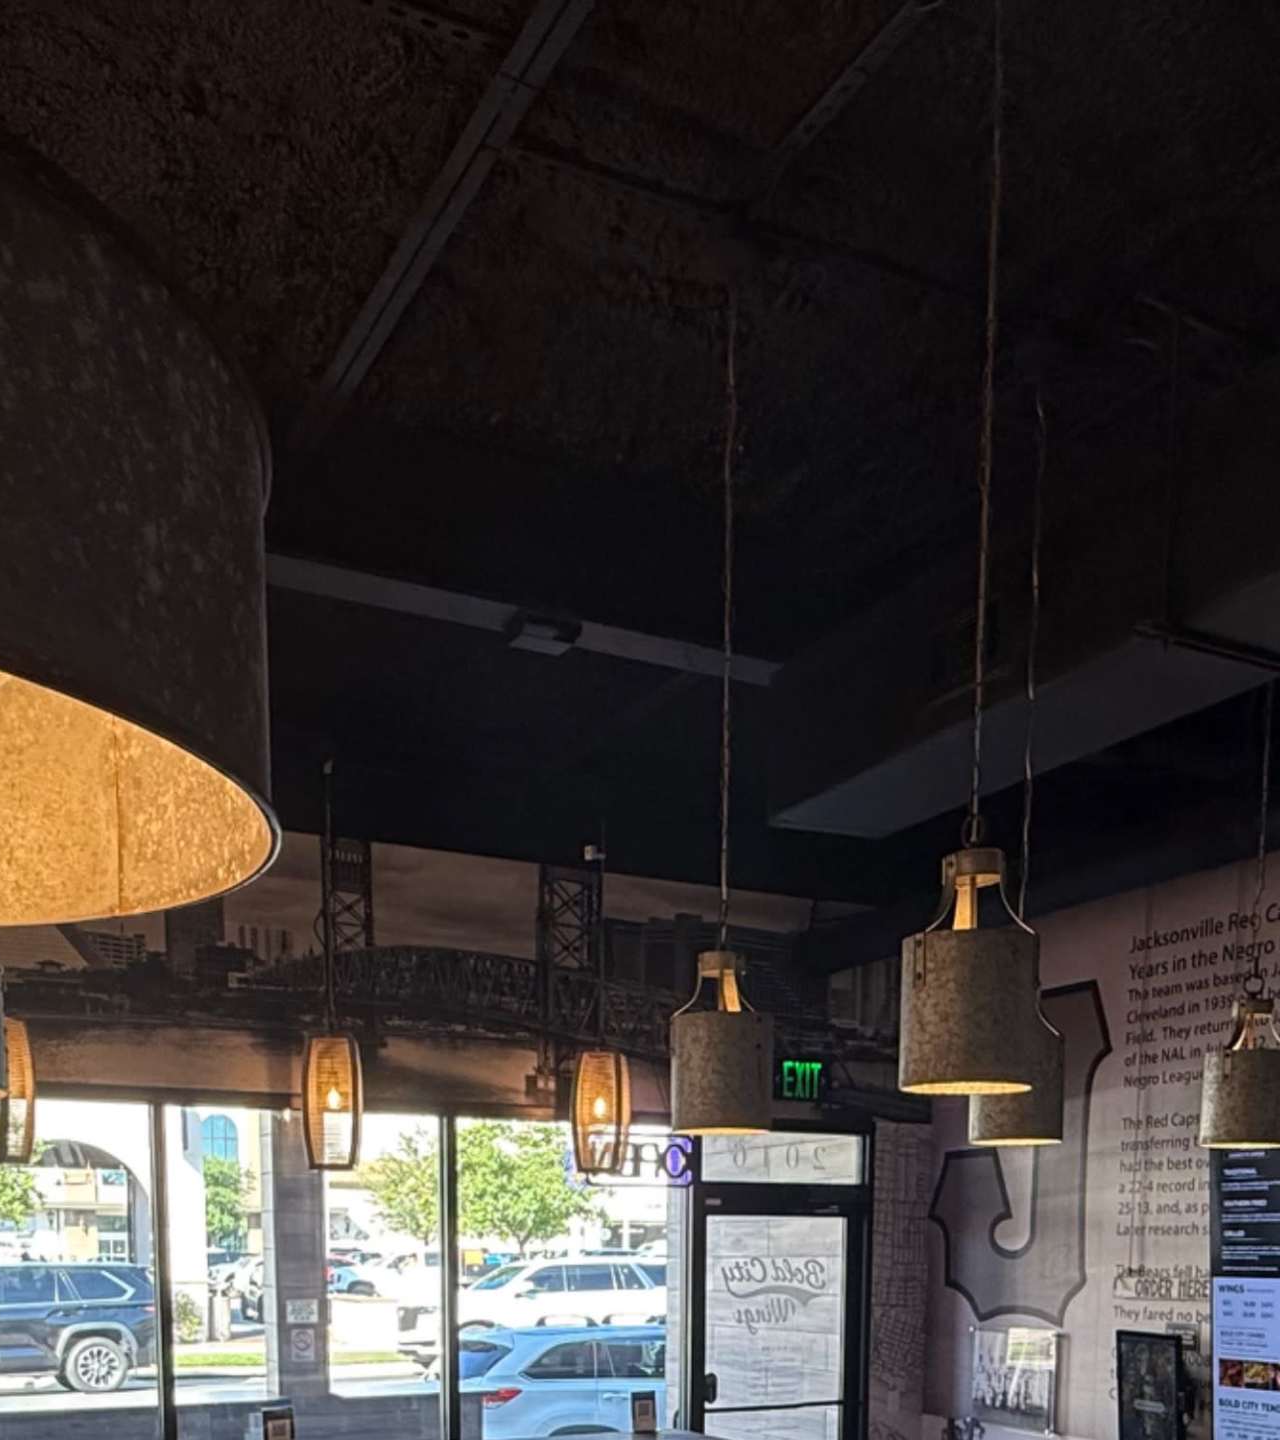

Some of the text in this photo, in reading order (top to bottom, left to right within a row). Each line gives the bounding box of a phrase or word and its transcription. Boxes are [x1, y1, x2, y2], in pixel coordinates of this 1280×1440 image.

[1129, 918, 1224, 954] Jacksonville
[1228, 912, 1261, 933] Red
[1128, 958, 1169, 981] Years
[1172, 951, 1187, 970] in
[1190, 948, 1218, 969] the
[1222, 936, 1274, 963] Negro
[1128, 986, 1148, 1003] The
[1151, 983, 1183, 999] team
[1185, 978, 1210, 993] was
[1126, 1003, 1185, 1026] Cleveland
[1188, 1000, 1200, 1015] in
[1126, 1026, 1157, 1045] Field.
[1161, 1020, 1191, 1043] They
[1124, 1052, 1136, 1067] of
[1139, 1050, 1158, 1065] the
[1161, 1048, 1186, 1063] NAL
[1189, 1046, 1201, 1059] in
[781, 1060, 824, 1100] EXIT
[1123, 1073, 1160, 1091] Negro
[1145, 1113, 1168, 1130] Red
[1120, 1134, 1191, 1154] transferring
[1144, 1154, 1193, 1171] the best
[1156, 1177, 1195, 1191] record
[1184, 1203, 1198, 1213] as
[1148, 1222, 1199, 1235] research
[1135, 1279, 1209, 1299] ORDER HERE
[1113, 1304, 1193, 1322] They fared no
[1218, 1398, 1260, 1411] BOLD CITY
